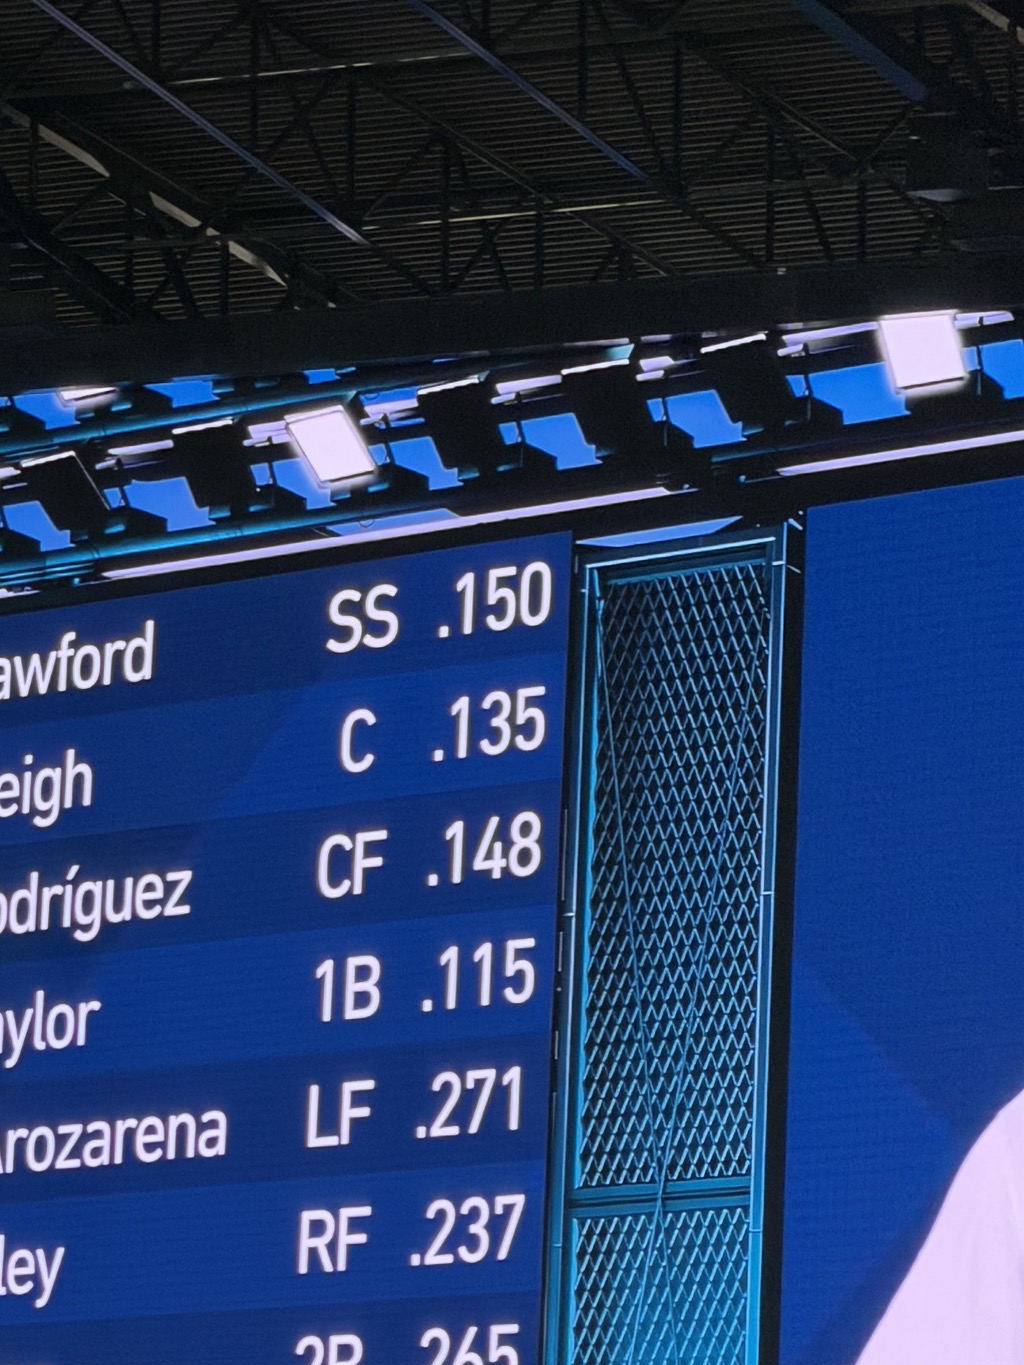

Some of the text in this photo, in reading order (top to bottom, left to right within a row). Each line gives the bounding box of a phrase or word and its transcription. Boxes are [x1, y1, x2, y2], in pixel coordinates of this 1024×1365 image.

[325, 582, 400, 654] SS
[437, 560, 553, 639] .150
[339, 707, 377, 774] C
[432, 684, 547, 763] .135
[317, 828, 389, 900] CF
[427, 810, 542, 888] .148
[315, 954, 382, 1023] 1B
[421, 936, 537, 1013] .115
[306, 1078, 376, 1149] LF
[415, 1064, 522, 1140] .271
[297, 1204, 373, 1276] RF
[409, 1192, 527, 1267] .237
